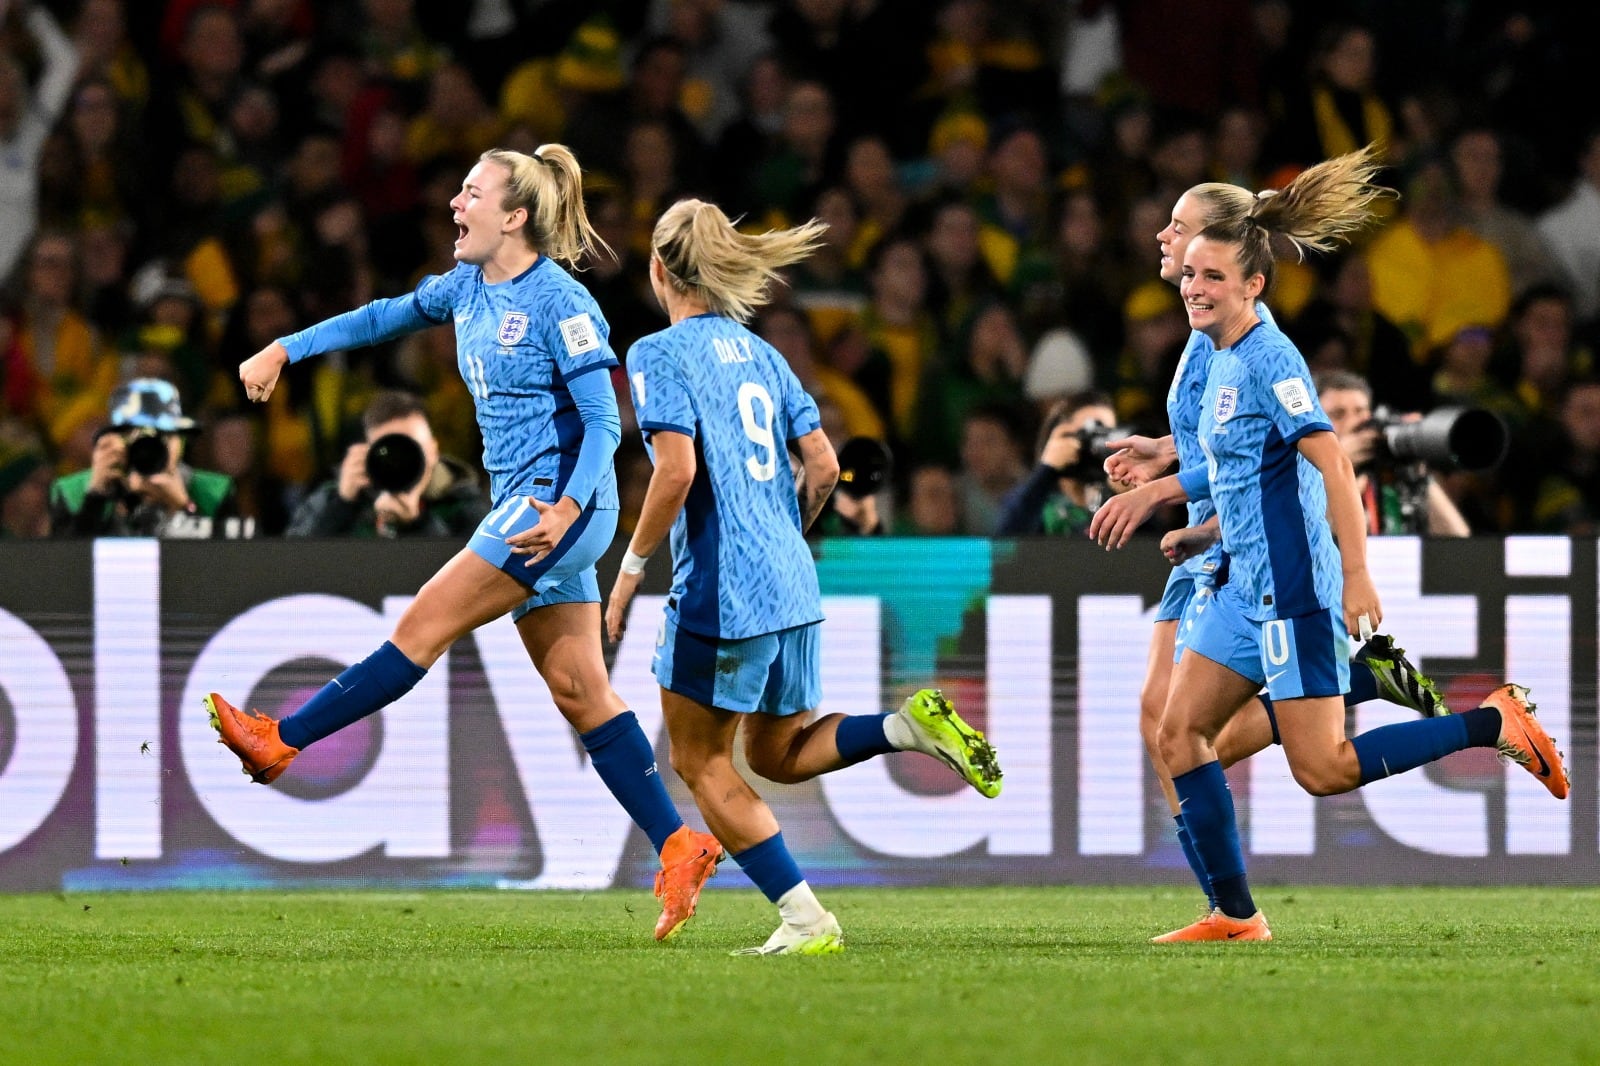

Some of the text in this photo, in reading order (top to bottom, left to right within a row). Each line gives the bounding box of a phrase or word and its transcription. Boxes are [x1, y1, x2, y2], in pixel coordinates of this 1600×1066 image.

[712, 336, 754, 364] DALY
[466, 354, 489, 400] 11
[737, 382, 776, 482] 9
[487, 495, 530, 535] 11
[815, 535, 1600, 858] unti
